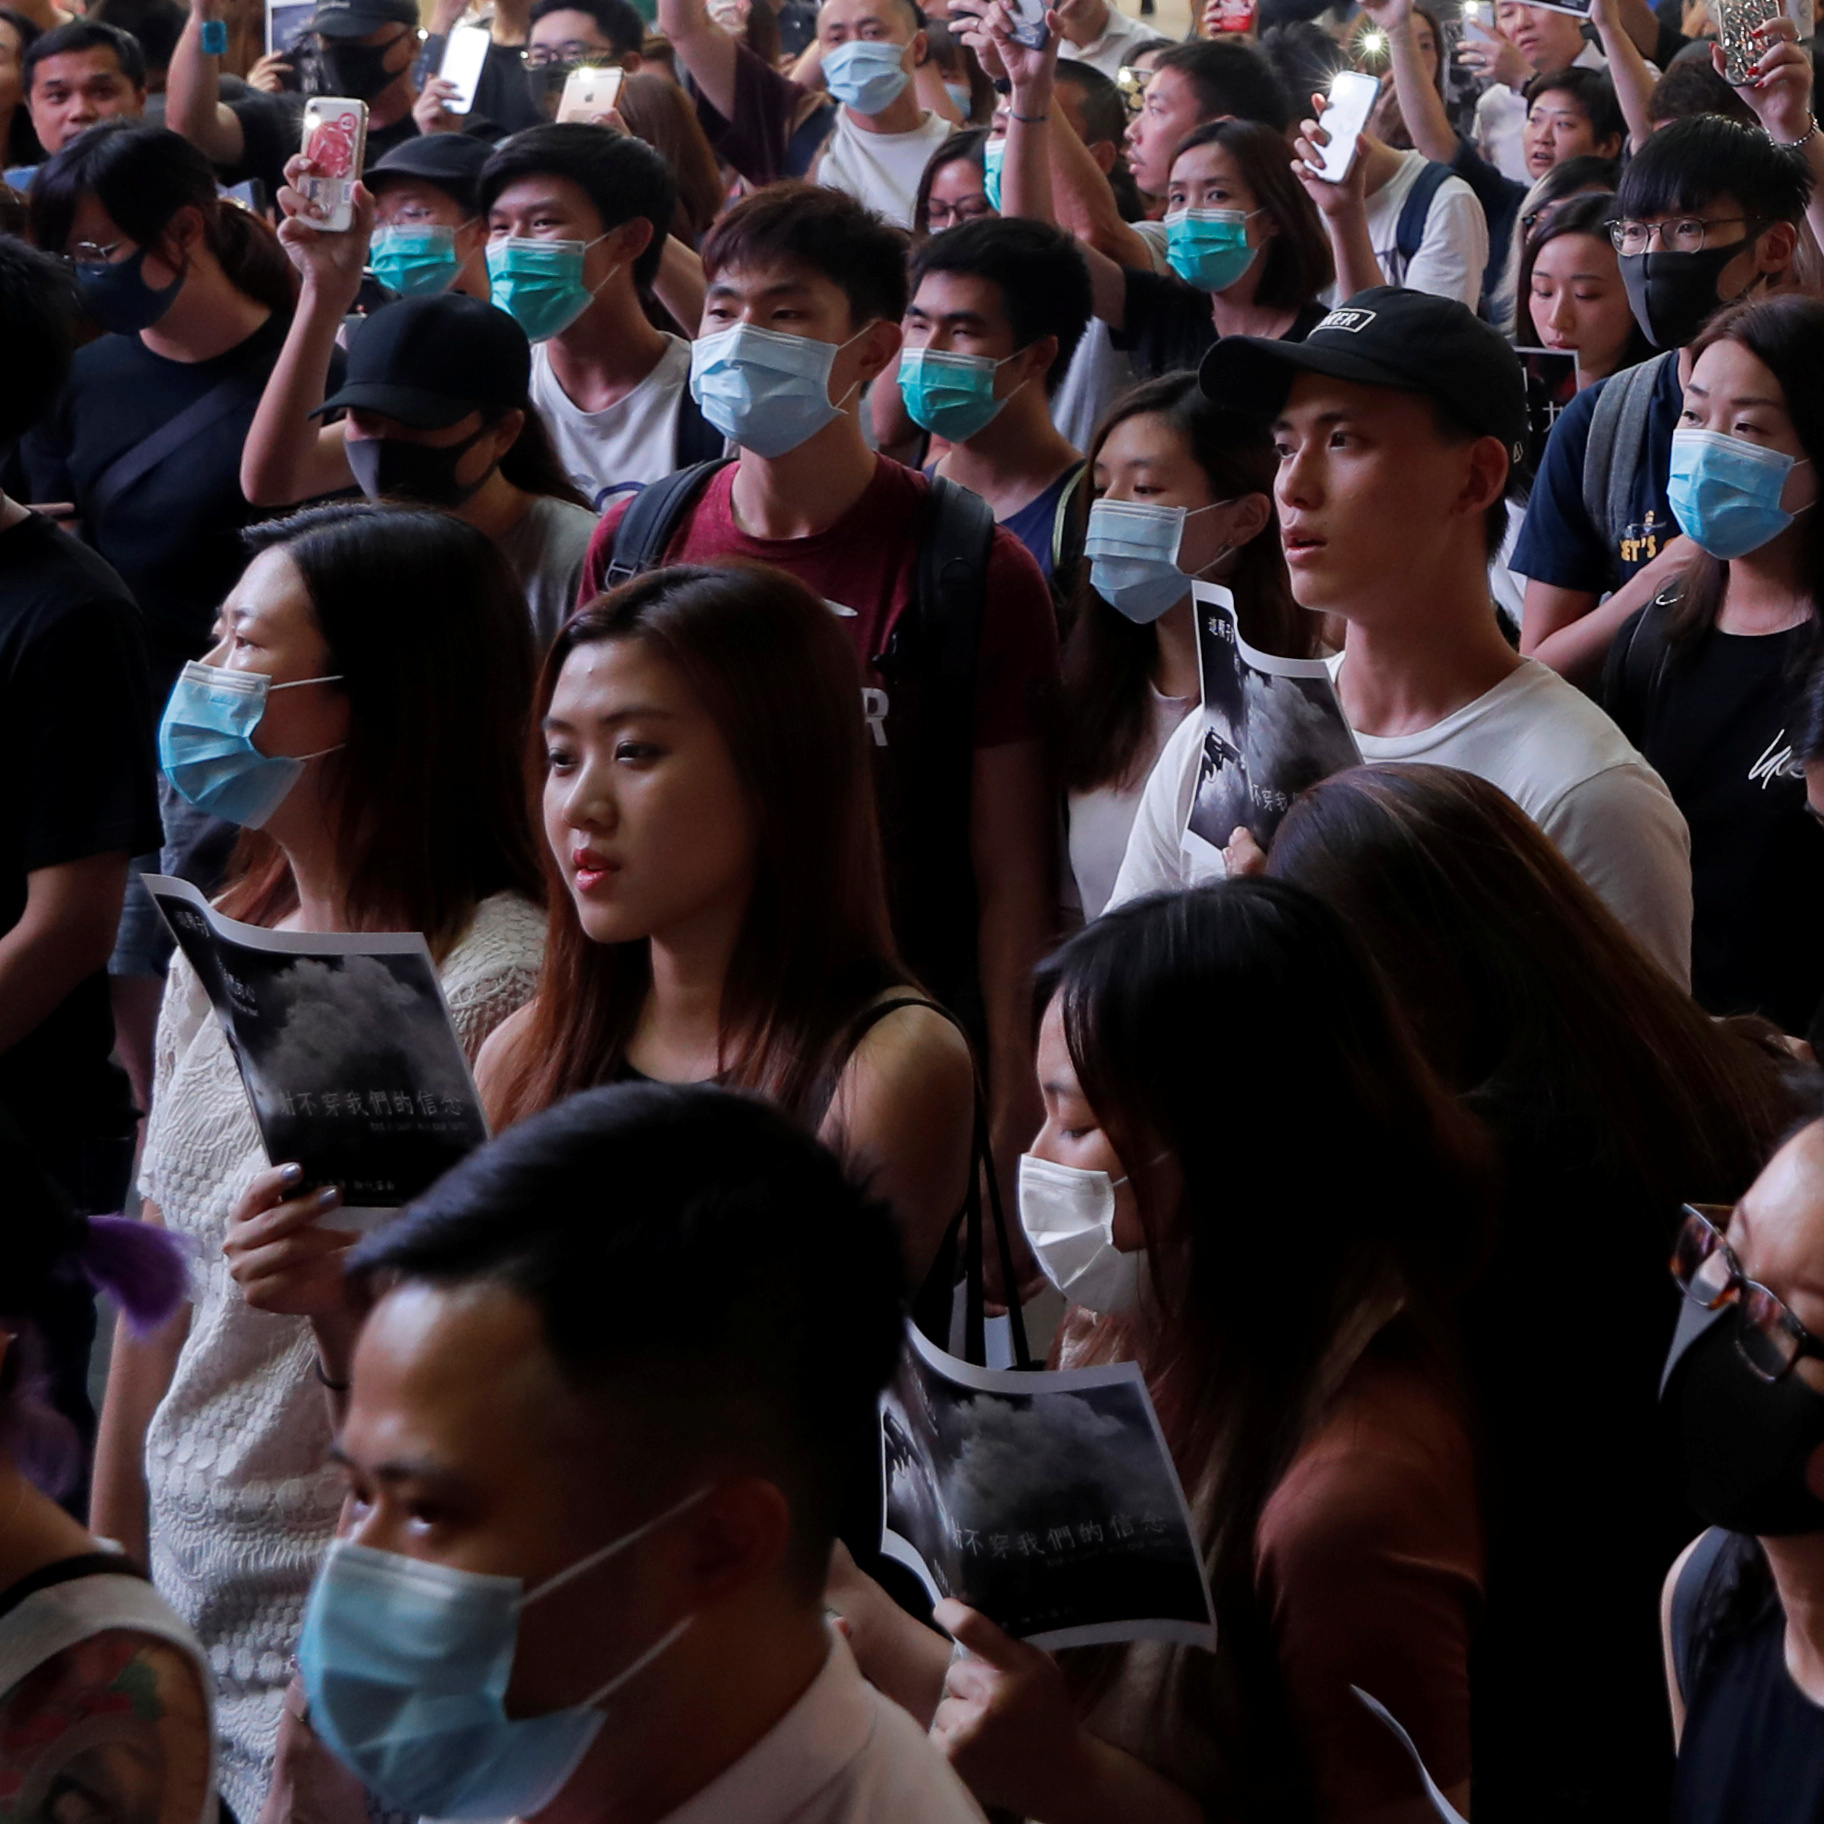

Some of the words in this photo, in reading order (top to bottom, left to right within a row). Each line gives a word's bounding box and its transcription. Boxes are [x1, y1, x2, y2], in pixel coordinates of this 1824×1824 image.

[279, 1089, 463, 1117] 射不穿我們的信念
